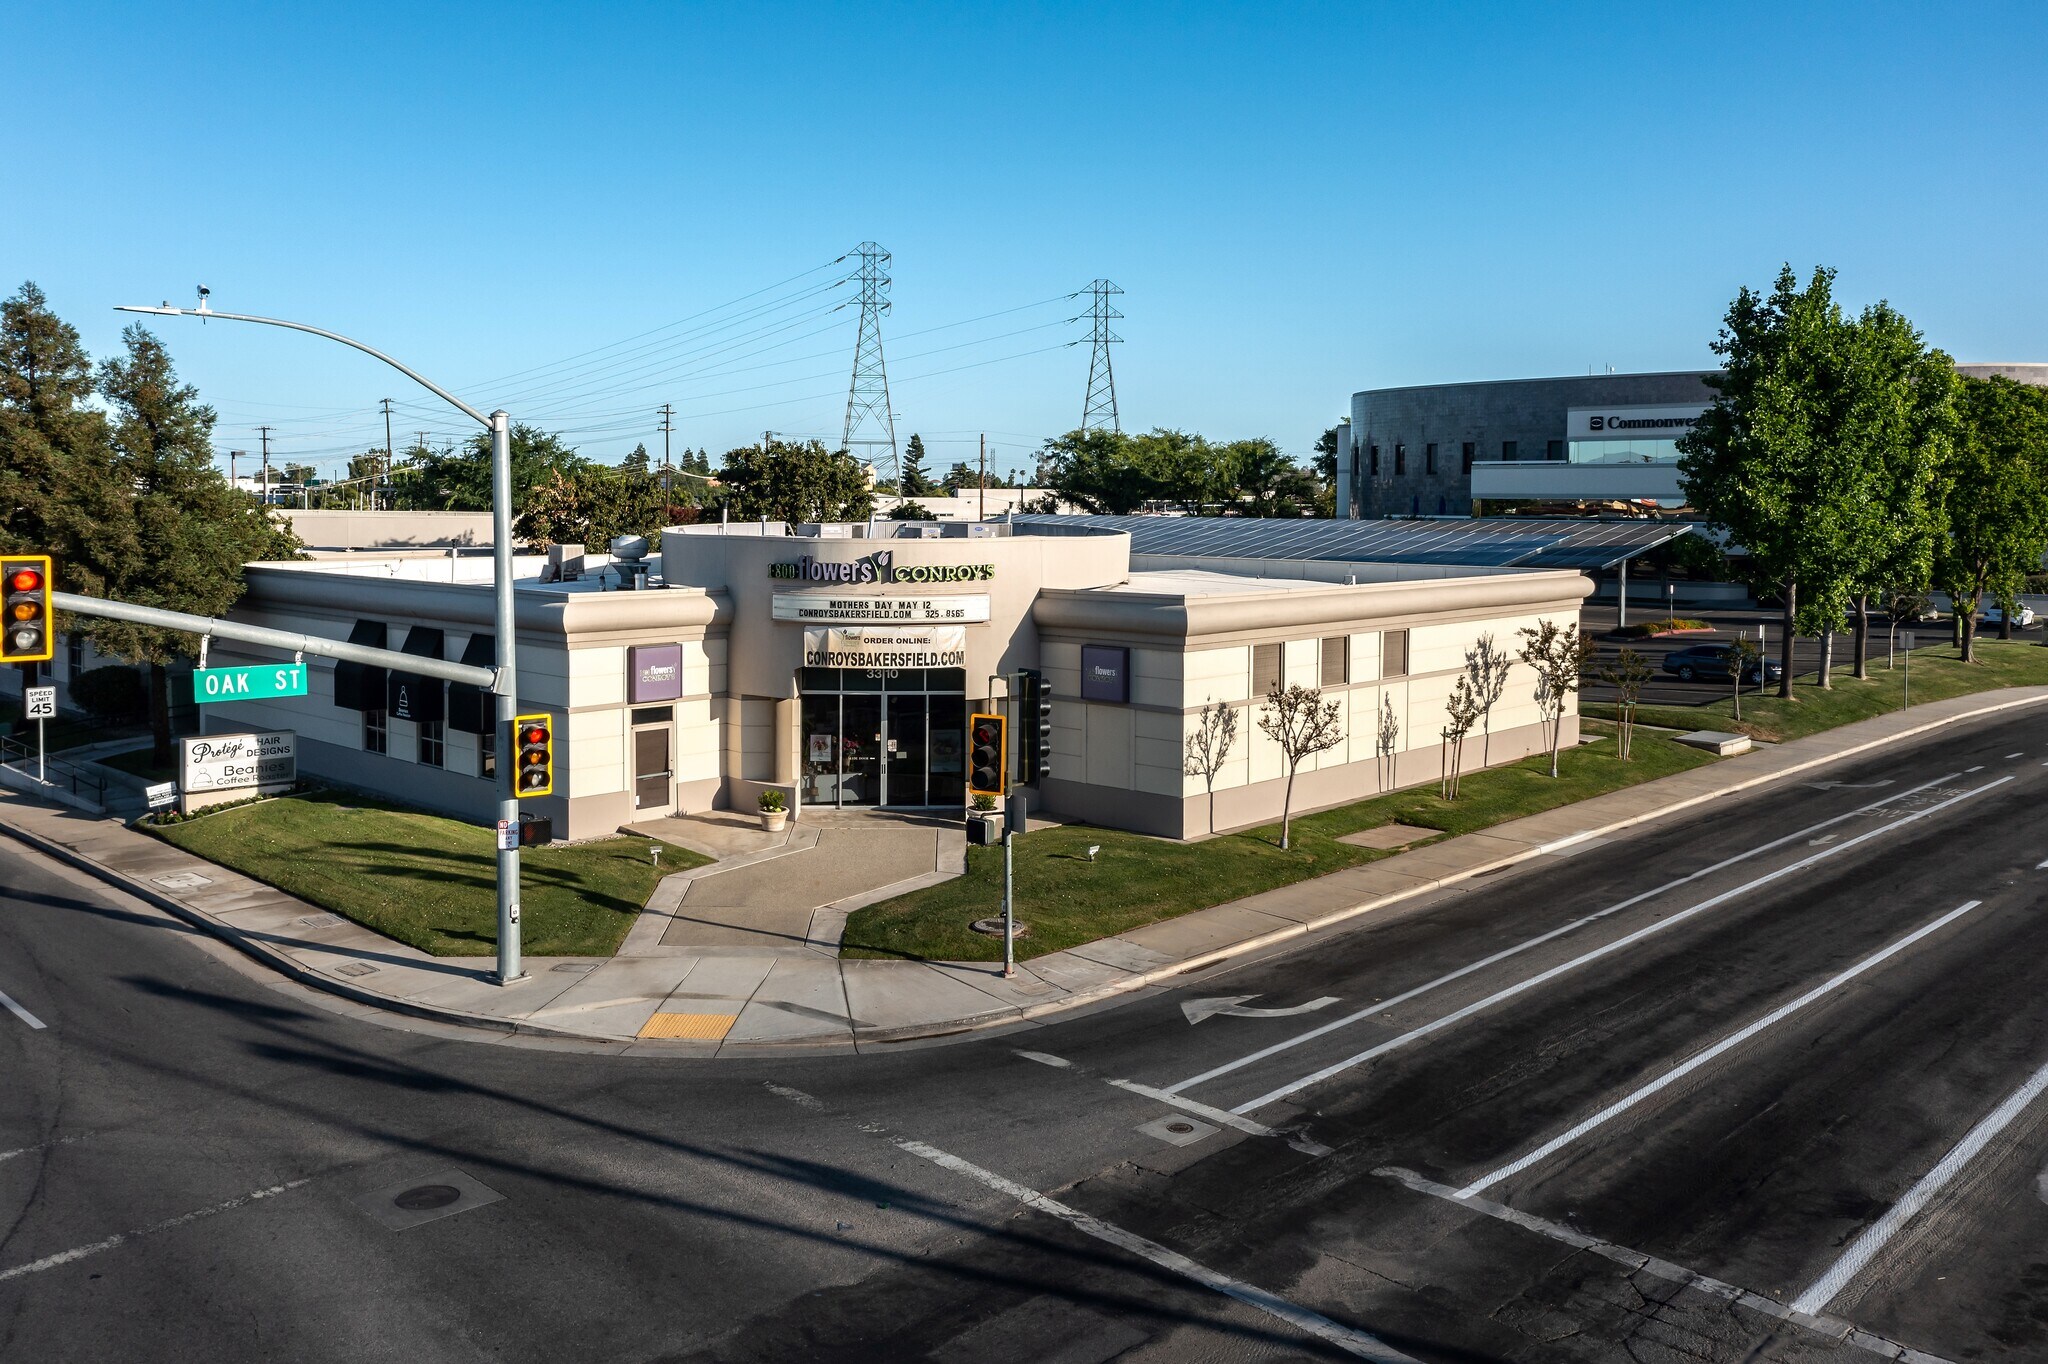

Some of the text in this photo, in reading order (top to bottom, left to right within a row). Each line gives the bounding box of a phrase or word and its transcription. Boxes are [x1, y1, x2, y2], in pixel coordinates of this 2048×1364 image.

[1607, 416, 1702, 429] Commonwea
[895, 564, 995, 581] CONROY'S
[829, 601, 931, 609] MOTHERS DAY MAY 12
[799, 609, 912, 619] CONROYSBAKERSFIELD.COM
[806, 651, 965, 667] CONROYSBAKERSFIELD.COM
[866, 669, 899, 679] 3310
[205, 669, 300, 695] OAK ST
[30, 703, 52, 715] 45
[257, 736, 281, 746] HAIR
[192, 739, 245, 763] Protégé
[246, 745, 291, 757] DESIGNS
[224, 762, 286, 777] Beanies
[216, 776, 250, 785] Coffee
[499, 821, 508, 829] NO
